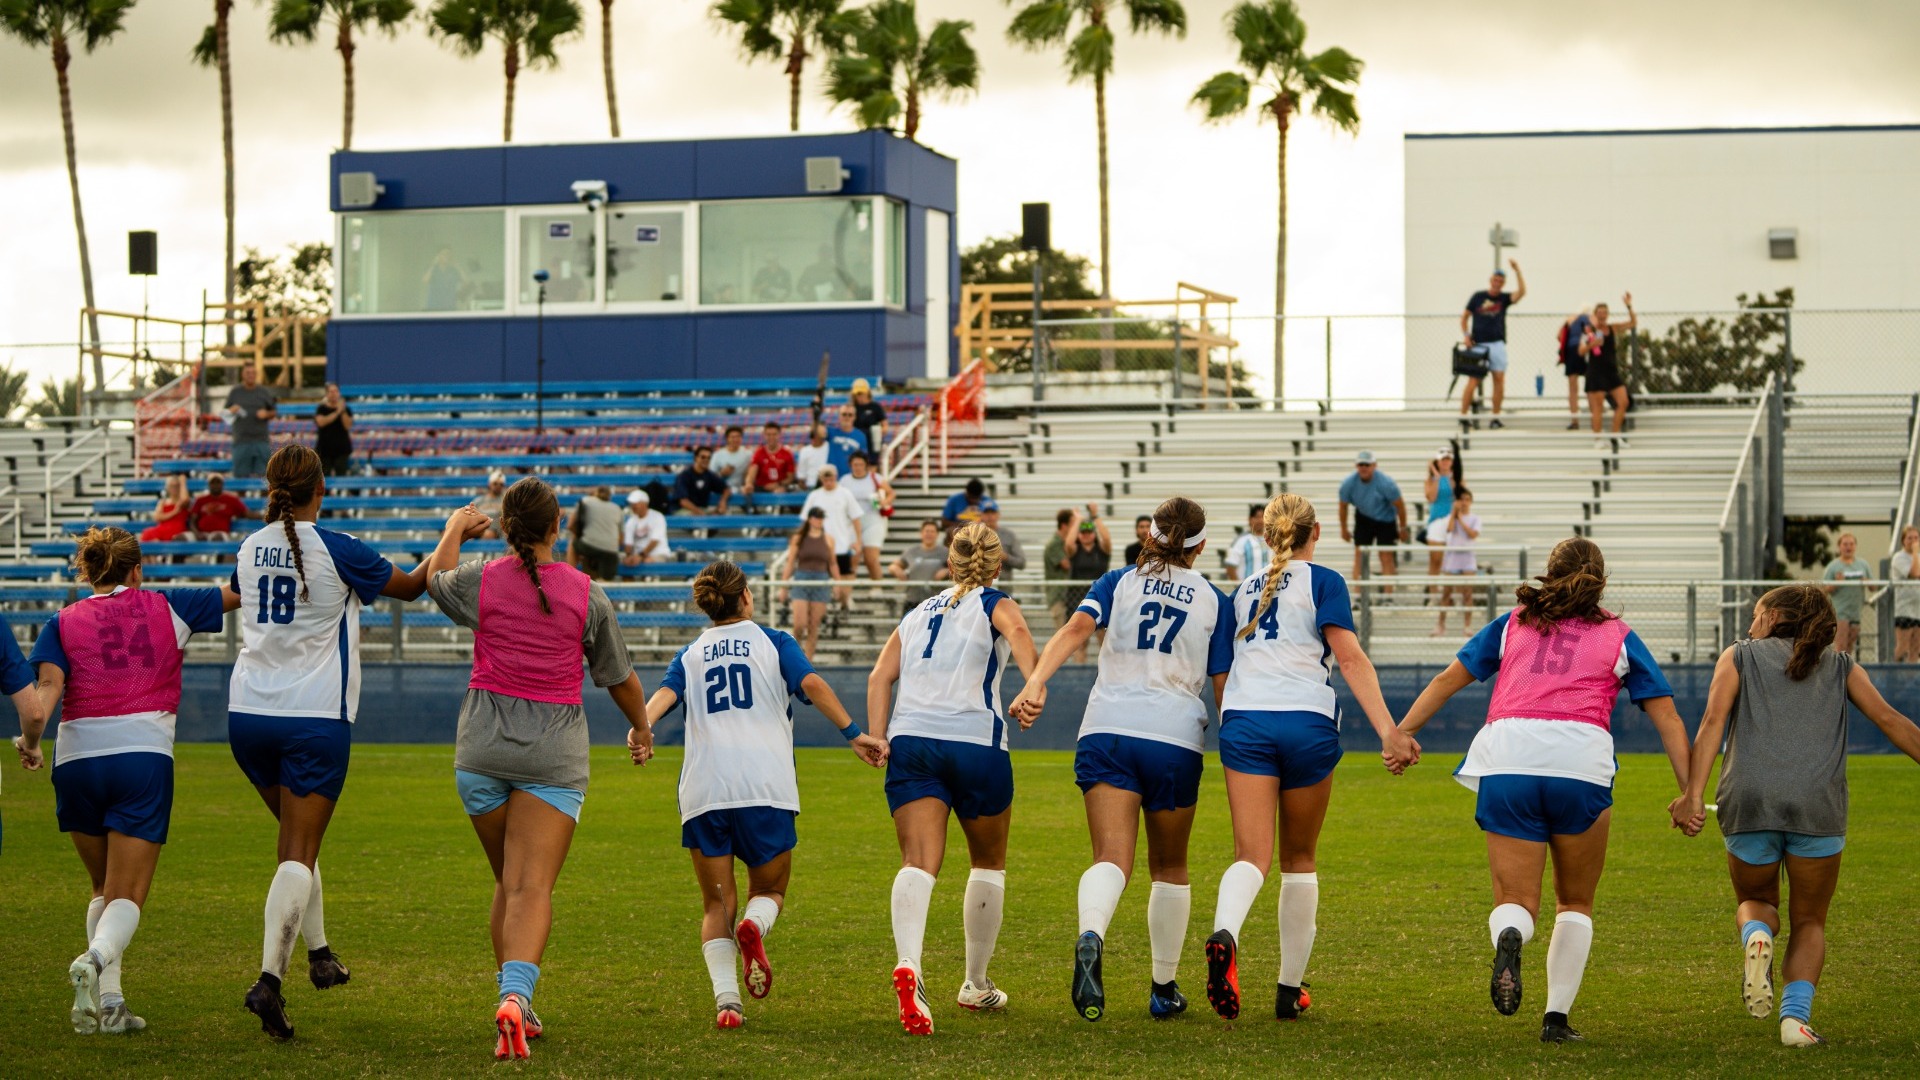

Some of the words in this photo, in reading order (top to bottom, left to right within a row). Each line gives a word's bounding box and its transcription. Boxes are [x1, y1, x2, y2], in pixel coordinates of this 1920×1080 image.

[254, 547, 304, 569] EAGLE
[257, 575, 296, 625] 18
[1143, 579, 1195, 604] EAGLES
[98, 623, 155, 670] 24
[704, 639, 751, 662] EAGLES
[1137, 602, 1188, 654] 27
[1530, 632, 1581, 675] 15
[705, 663, 753, 714] 20
